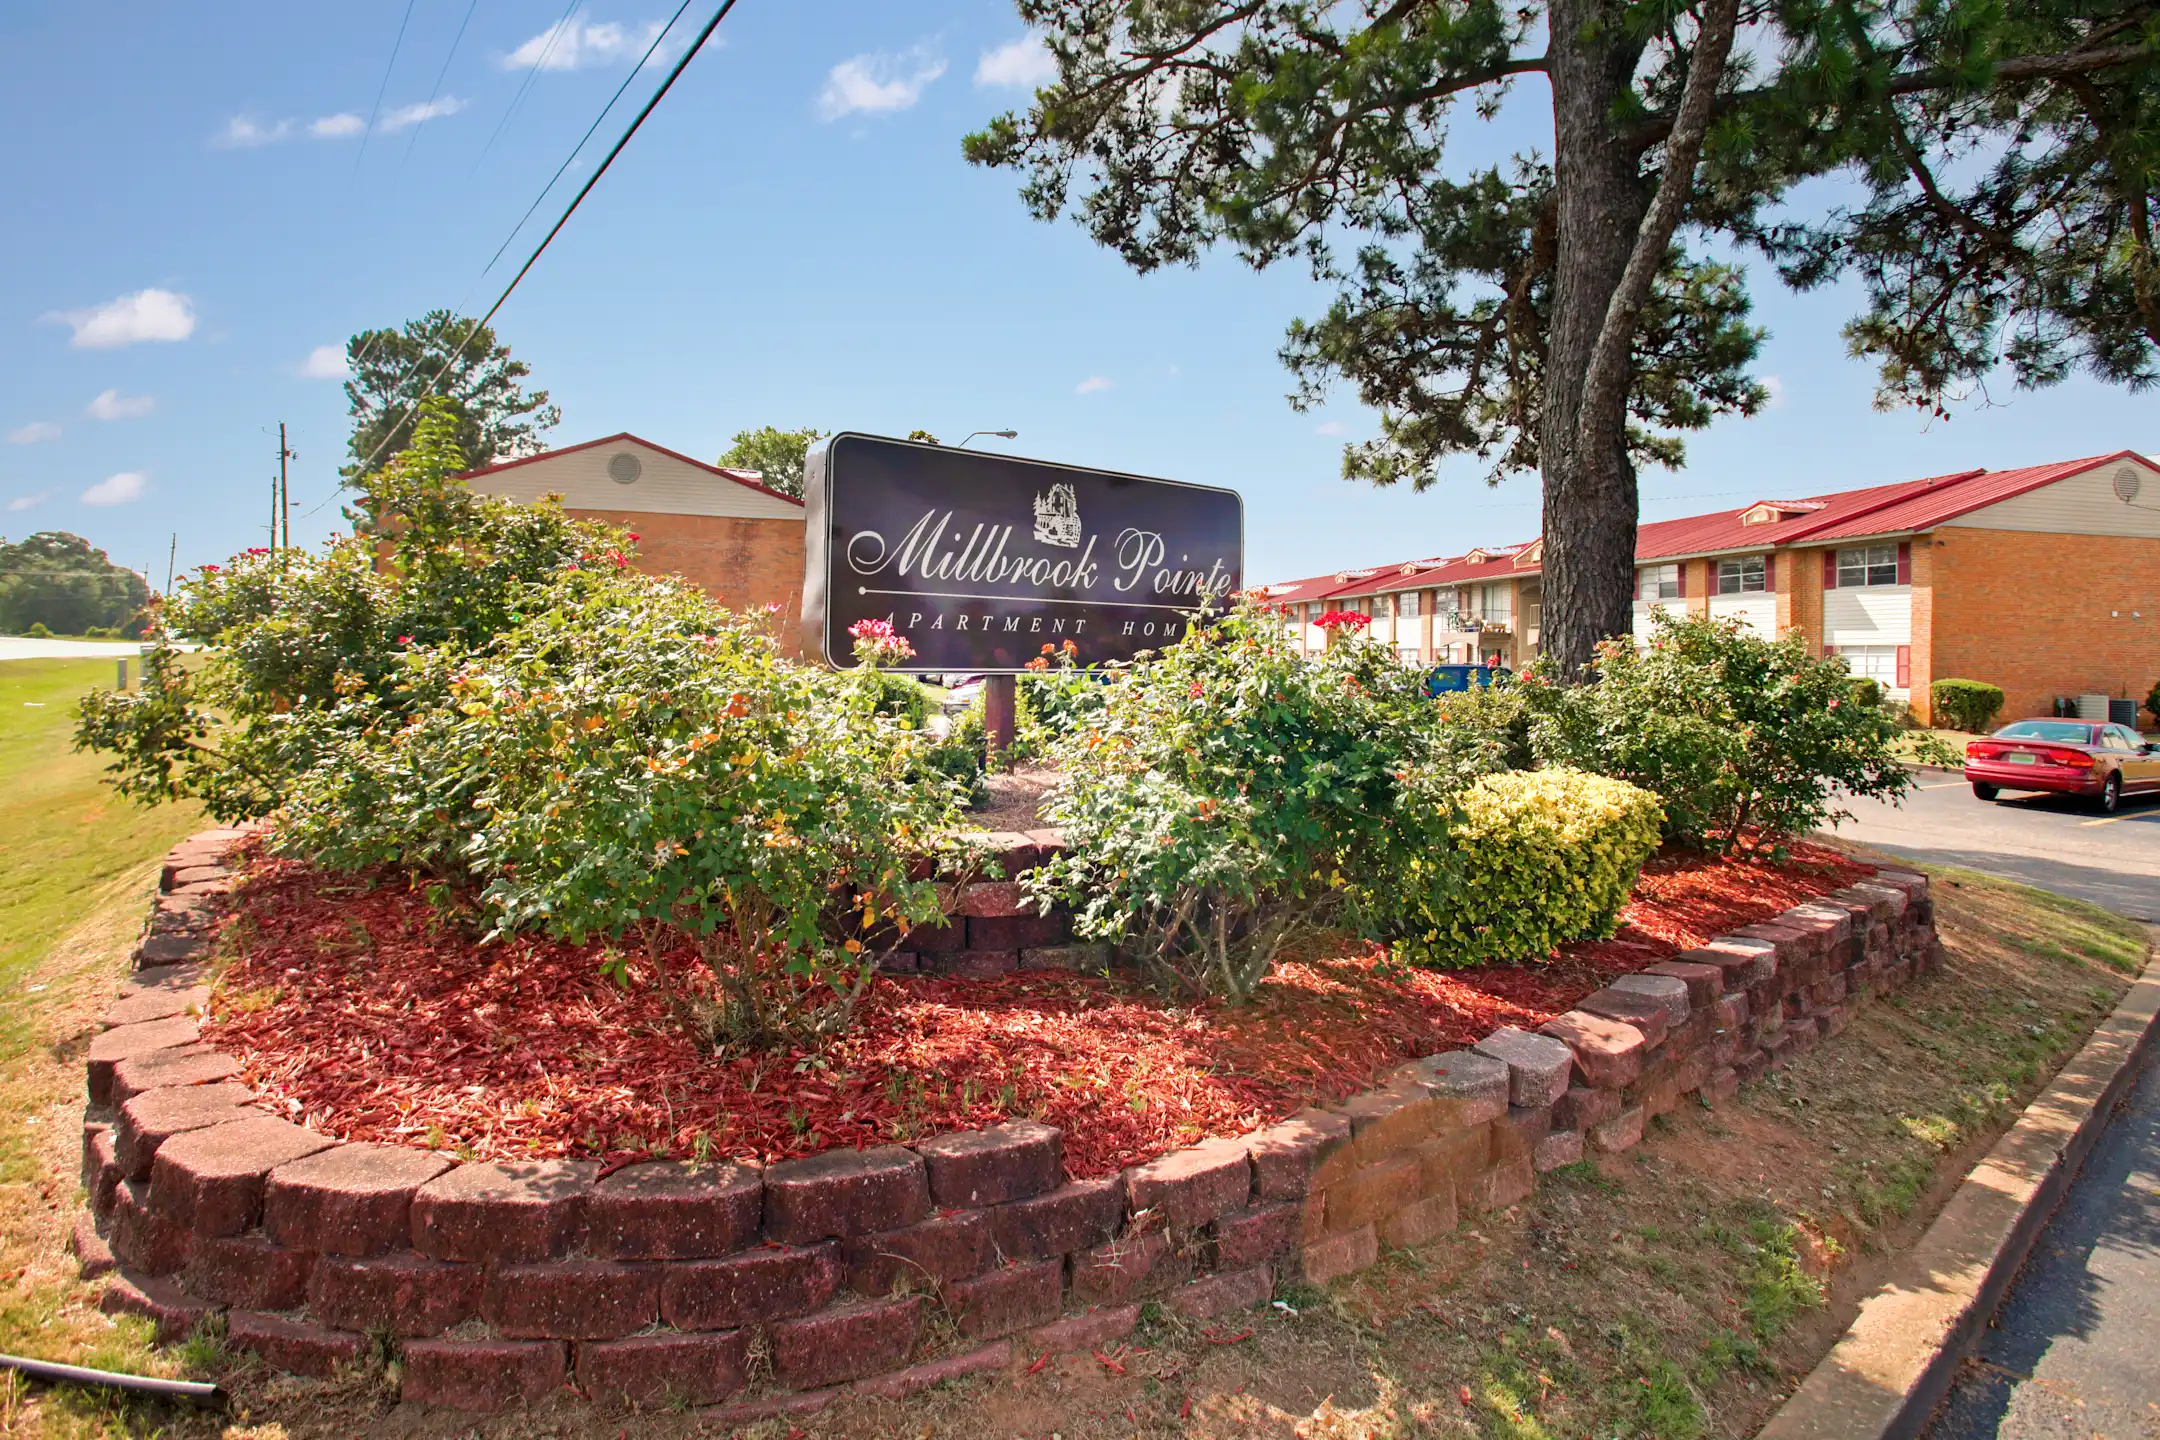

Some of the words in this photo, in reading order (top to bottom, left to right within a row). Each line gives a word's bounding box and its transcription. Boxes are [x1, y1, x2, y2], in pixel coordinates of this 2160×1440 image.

[847, 508, 1098, 588] Millbrook
[1113, 527, 1232, 598] Pointe
[884, 612, 1087, 634] APARTMENT
[1122, 621, 1209, 638] HOM
